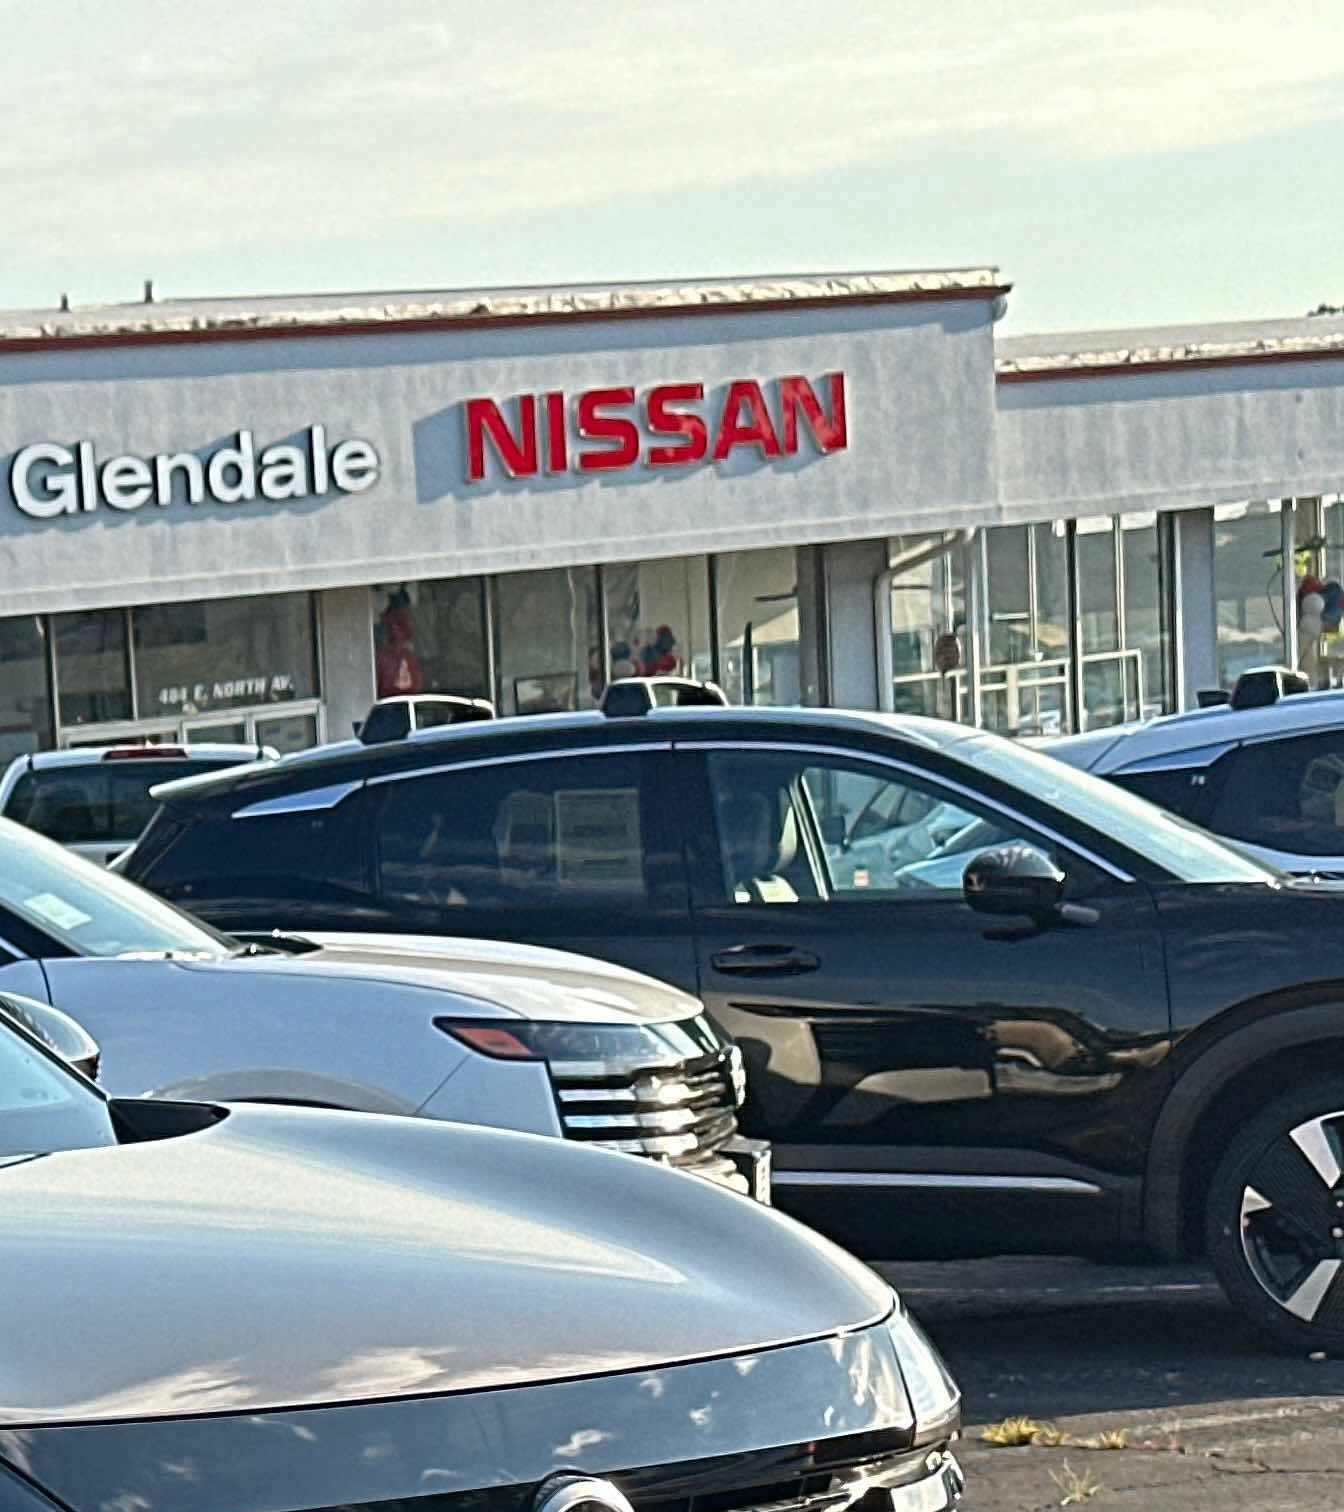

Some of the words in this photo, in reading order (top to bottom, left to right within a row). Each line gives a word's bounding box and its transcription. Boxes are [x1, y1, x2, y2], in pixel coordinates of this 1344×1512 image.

[10, 425, 381, 519] Glendale
[464, 371, 847, 482] NISSAN
[213, 677, 266, 699] NORTH
